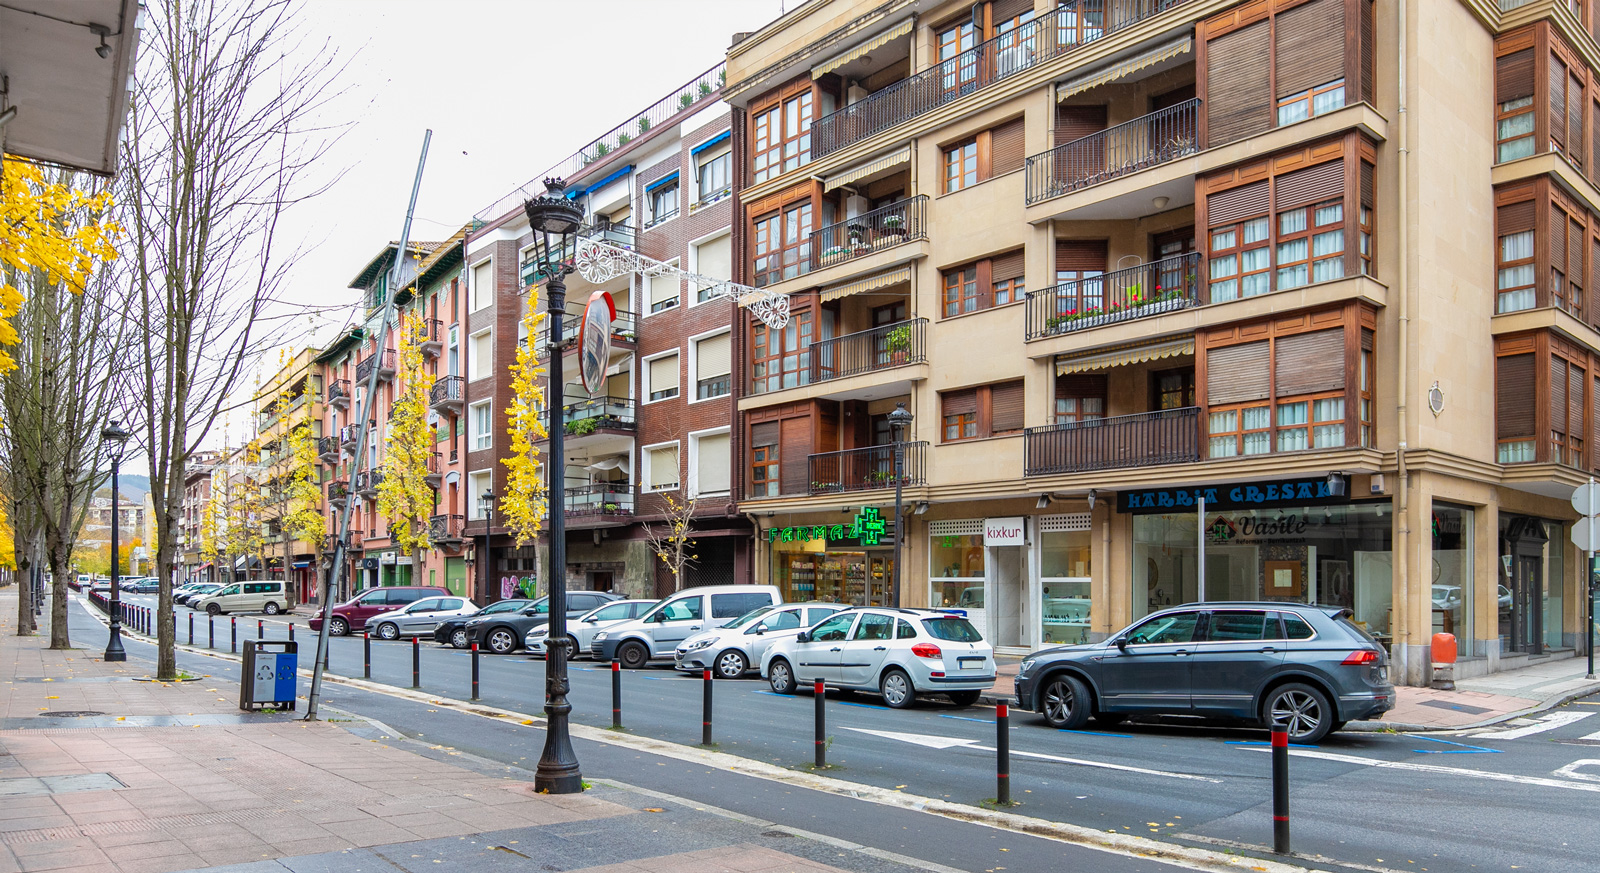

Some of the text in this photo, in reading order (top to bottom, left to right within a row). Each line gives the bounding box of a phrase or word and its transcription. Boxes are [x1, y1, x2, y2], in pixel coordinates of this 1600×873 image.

[1229, 481, 1331, 503] GRESAK
[987, 526, 1022, 539] kixkur
[1239, 514, 1307, 536] Vasile
